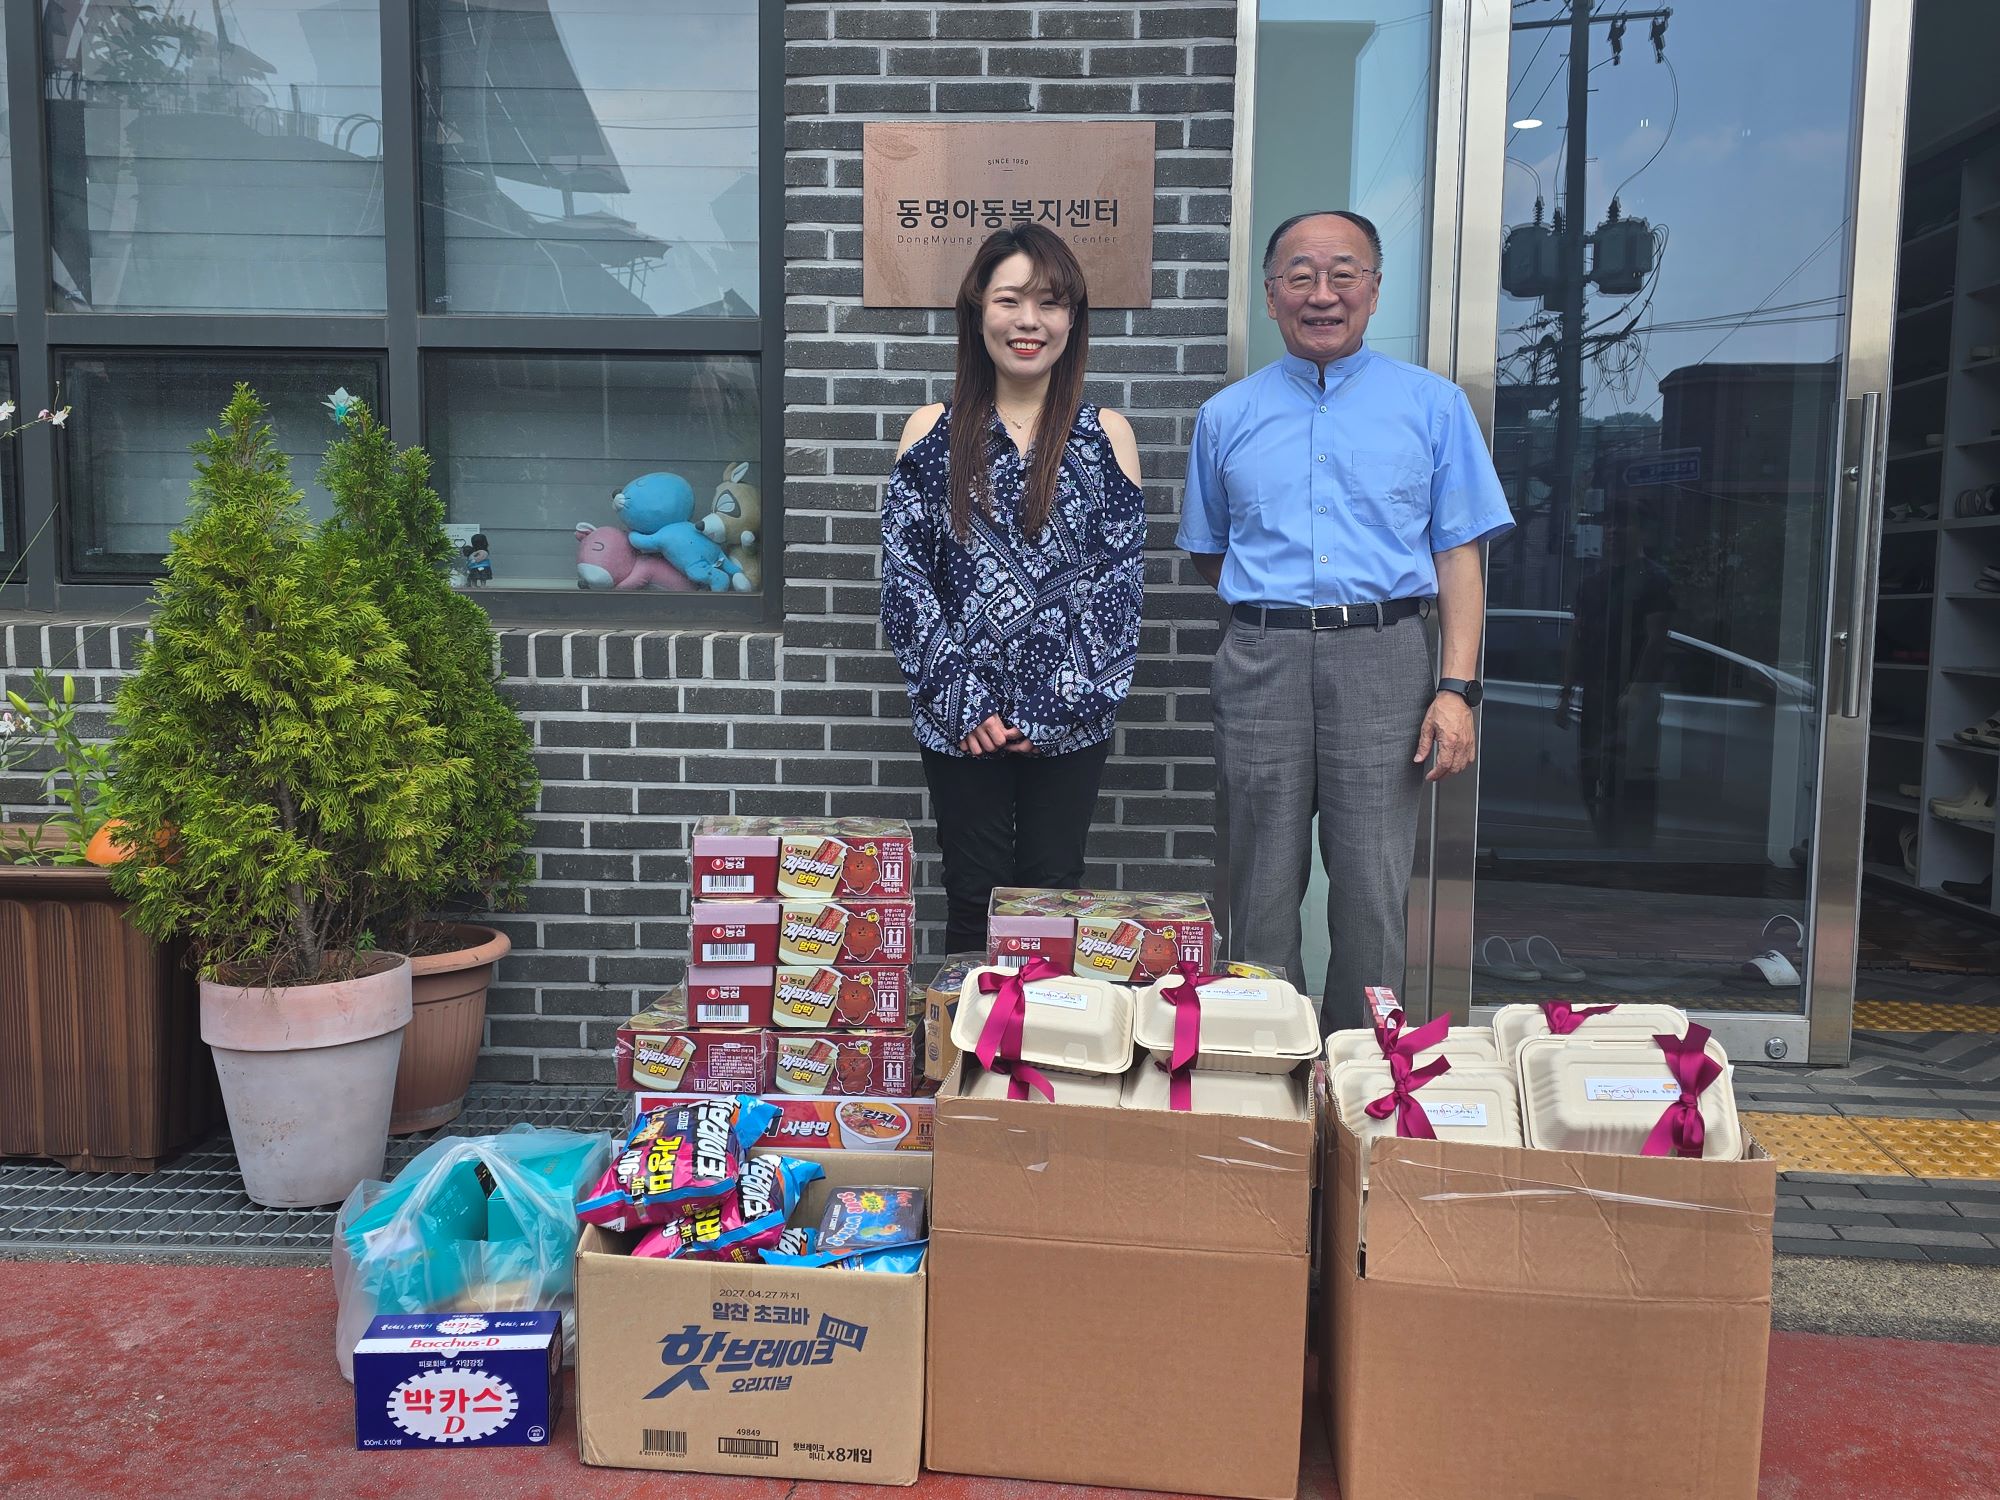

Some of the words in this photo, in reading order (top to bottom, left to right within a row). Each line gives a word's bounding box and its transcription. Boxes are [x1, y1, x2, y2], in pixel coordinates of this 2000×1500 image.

[987, 158, 1009, 166] SINCE
[897, 199, 1118, 229] 동명아동복지센터
[897, 235, 973, 245] DongMyung
[1073, 234, 1117, 244] Center
[782, 855, 840, 879] 짜파게티
[782, 922, 842, 945] 짜파게티
[1091, 929, 1107, 938] 농심
[1077, 937, 1137, 961] 짜파게티
[1093, 956, 1117, 970] 범벅
[776, 984, 836, 1008] 짜파게티
[636, 1048, 685, 1069] 짜파게티
[778, 1054, 831, 1075] 짜파게티
[862, 1109, 897, 1124] 김치
[780, 1119, 831, 1138] 사발면
[837, 1191, 864, 1214] SOUR
[719, 1288, 777, 1299] 2027.04.27
[712, 1302, 749, 1322] 알찬
[753, 1304, 810, 1325] 초코바
[444, 1322, 482, 1331] 박카스
[826, 1321, 859, 1344] 미니
[410, 1337, 500, 1348] Bacchus-D
[418, 1360, 446, 1368] 피로회복
[456, 1359, 484, 1367] 자양강장
[641, 1325, 838, 1400] 핫브레이크
[729, 1375, 793, 1393] 오리지널
[403, 1387, 503, 1415] 박카스
[443, 1416, 465, 1435] D
[736, 1428, 761, 1437] 49849
[827, 1447, 872, 1463] x8개입
